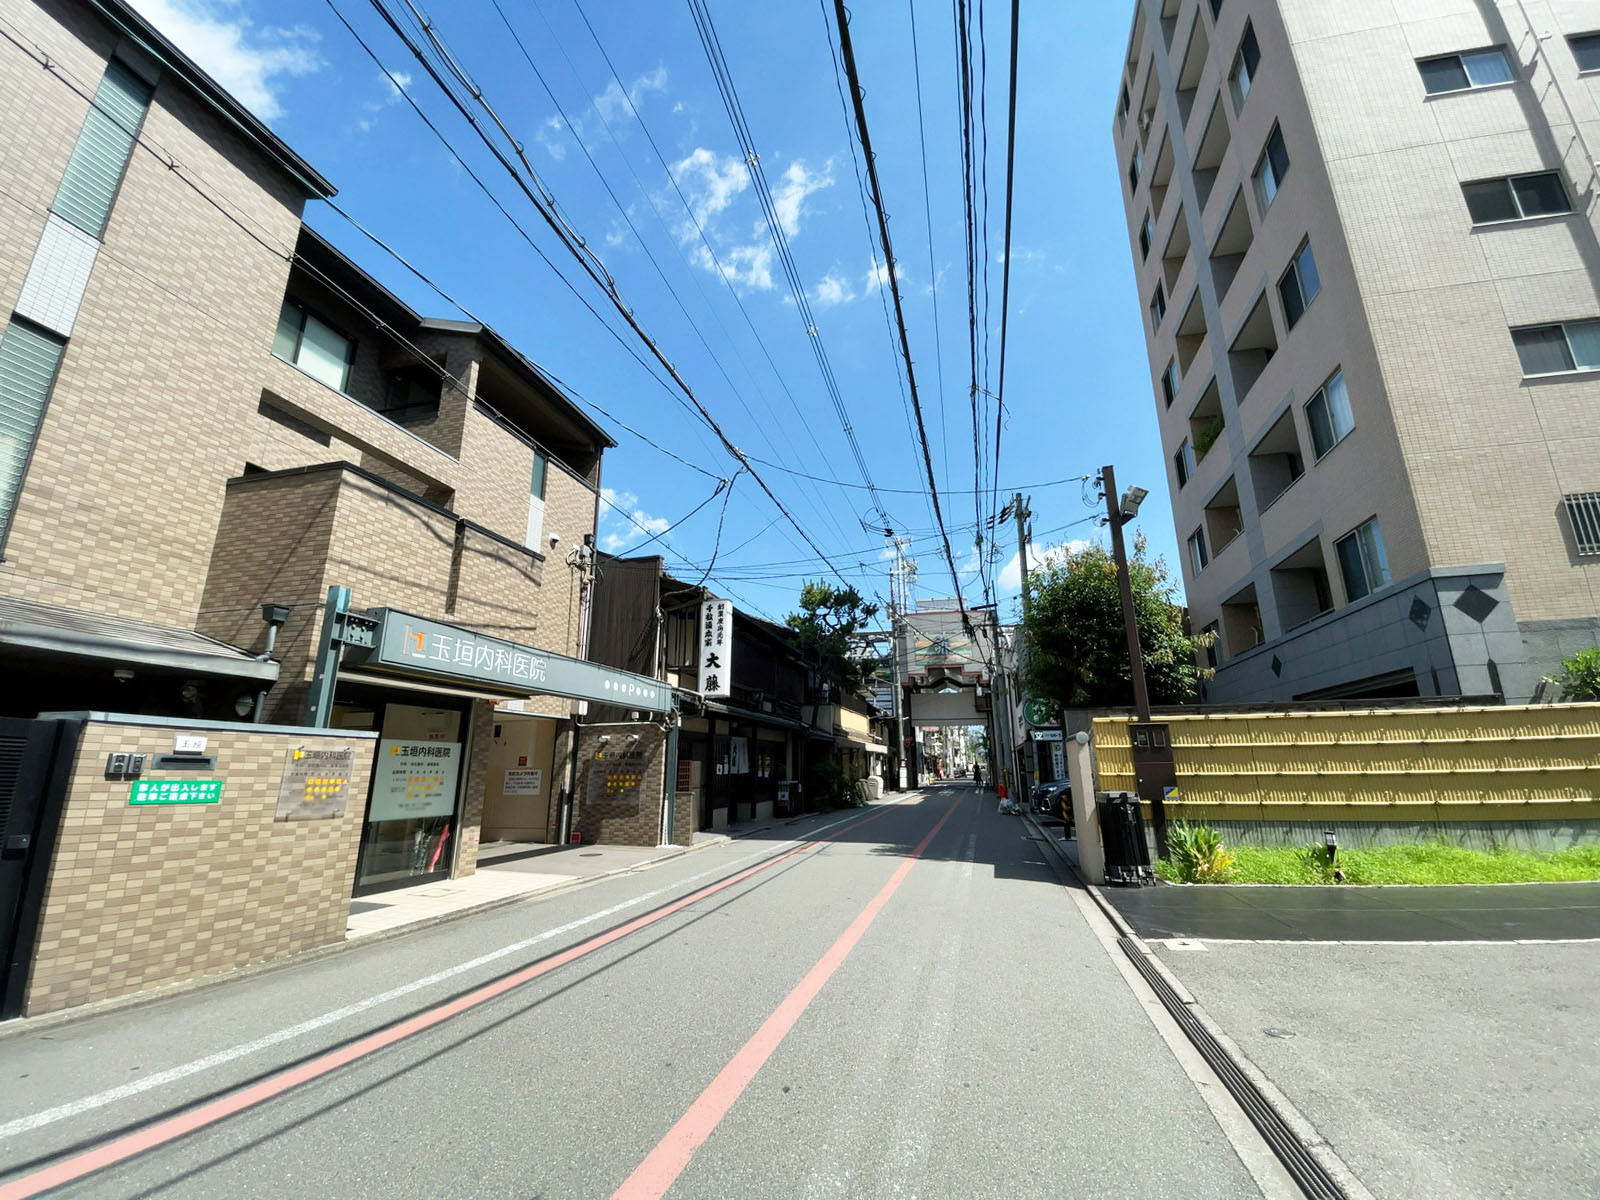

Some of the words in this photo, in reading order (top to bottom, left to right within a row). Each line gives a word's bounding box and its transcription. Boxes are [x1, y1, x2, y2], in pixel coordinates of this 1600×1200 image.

[428, 633, 547, 682] 玉垣内科医院
[704, 652, 721, 692] 大藤
